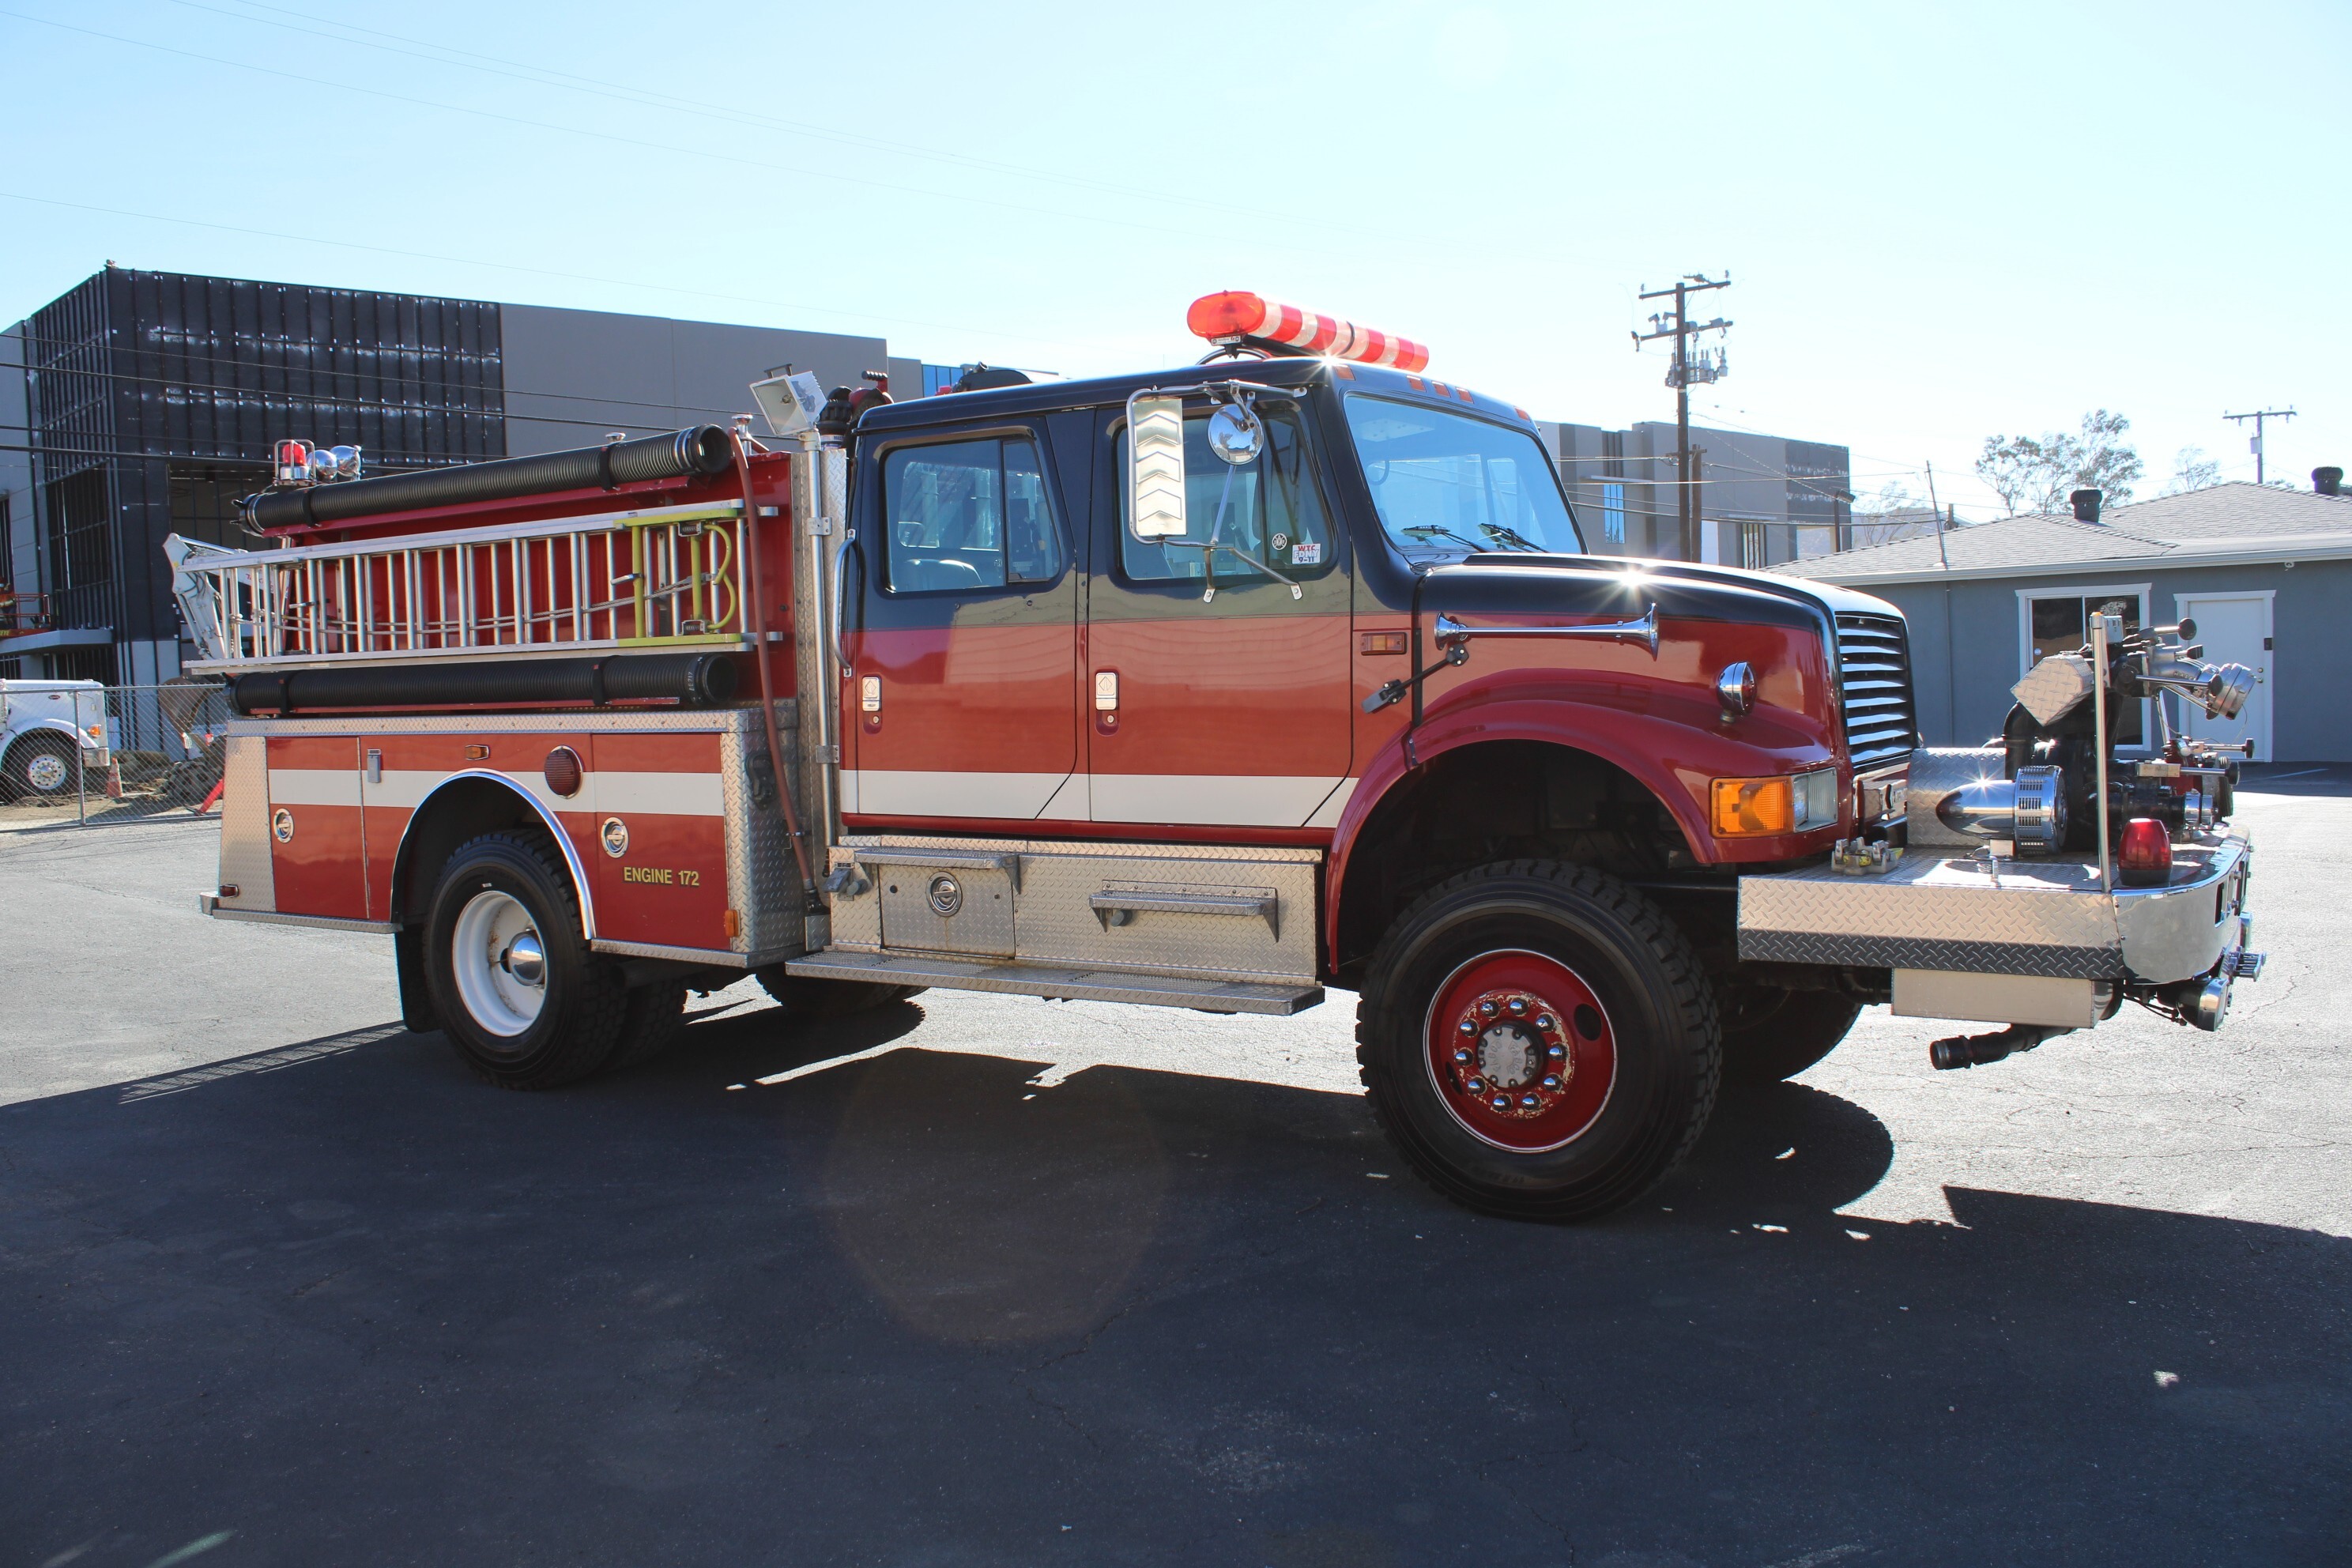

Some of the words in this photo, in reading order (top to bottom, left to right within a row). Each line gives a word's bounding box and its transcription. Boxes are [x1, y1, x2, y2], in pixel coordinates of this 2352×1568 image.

[1294, 549, 1319, 559] FDNY
[624, 866, 673, 884] ENGINE
[678, 870, 699, 886] 172
